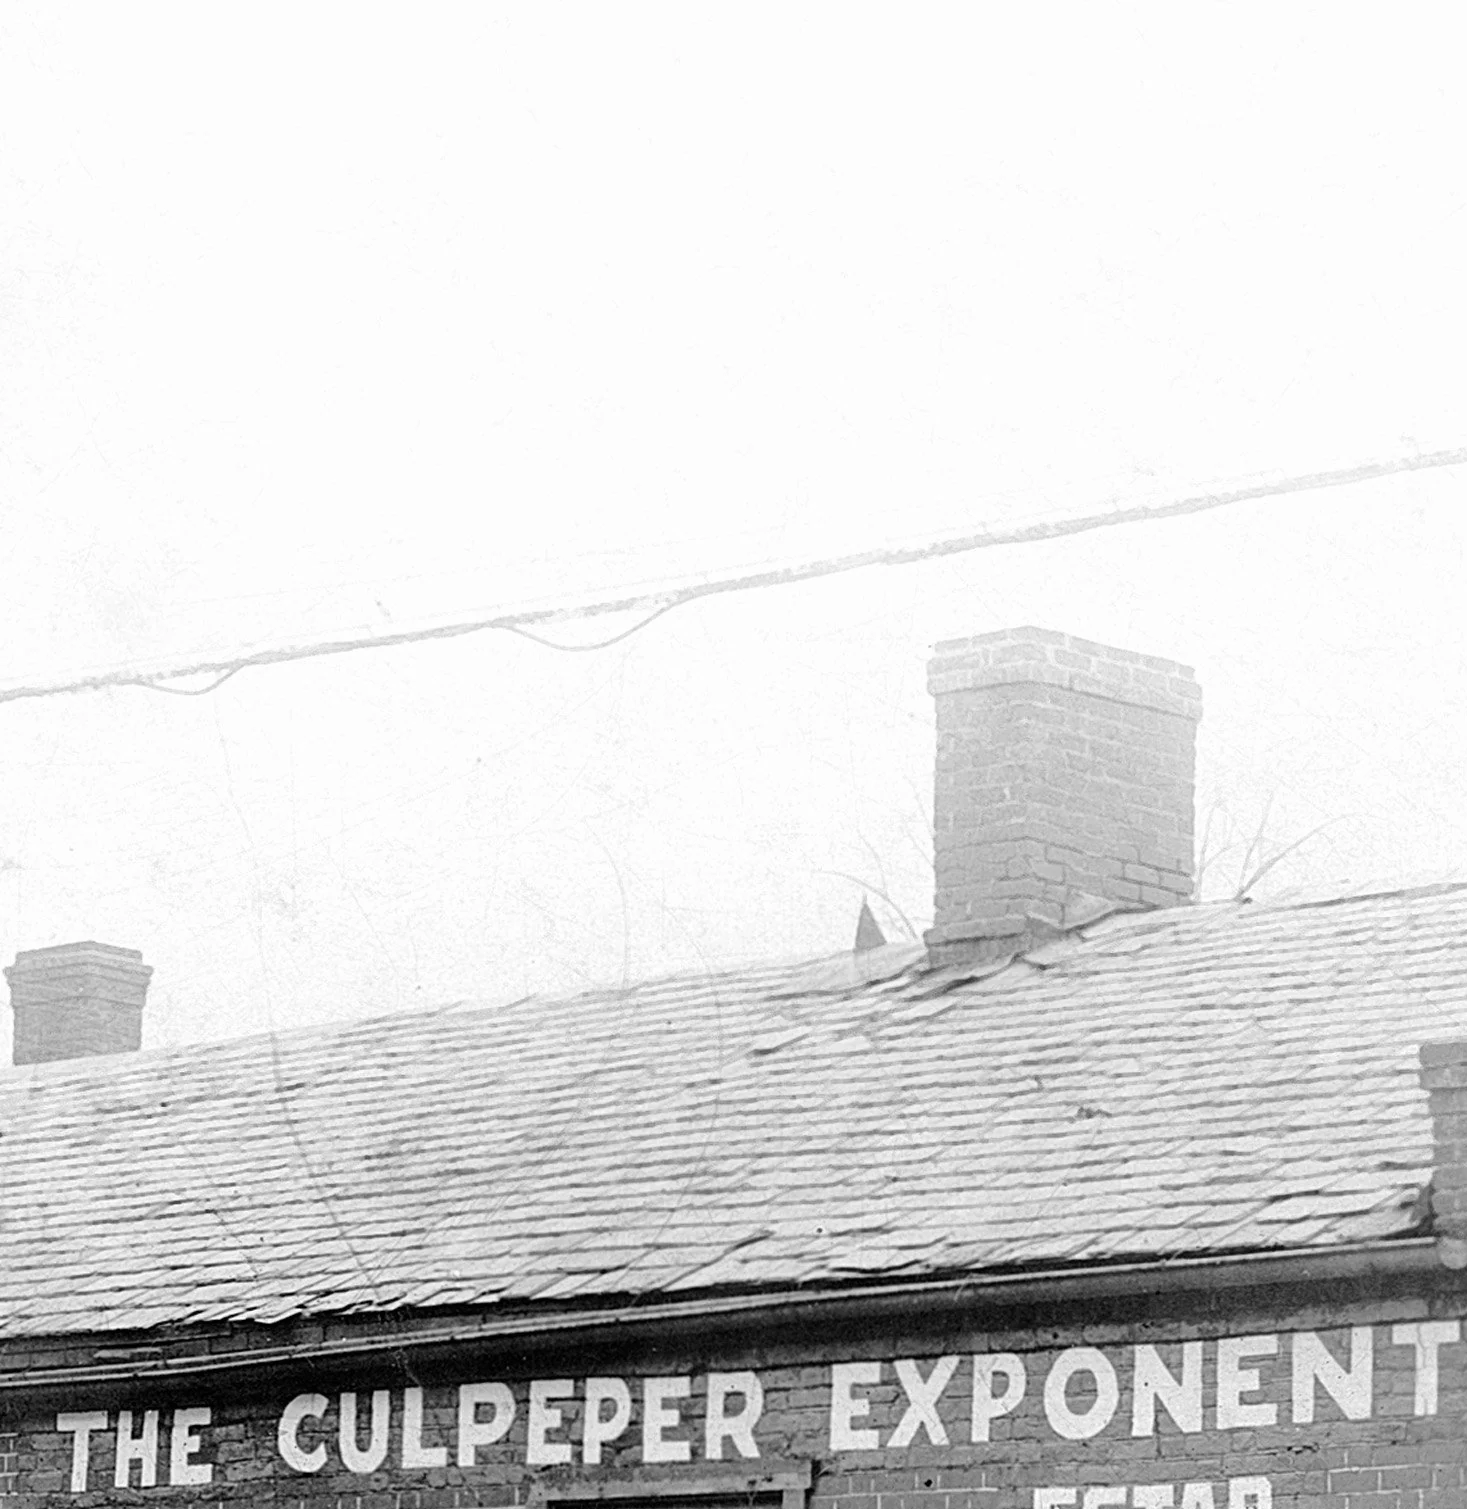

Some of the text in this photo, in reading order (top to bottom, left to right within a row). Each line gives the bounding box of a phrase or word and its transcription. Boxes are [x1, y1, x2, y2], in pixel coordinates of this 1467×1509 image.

[57, 1320, 1461, 1492] THE CULPEPER EXPONENT
